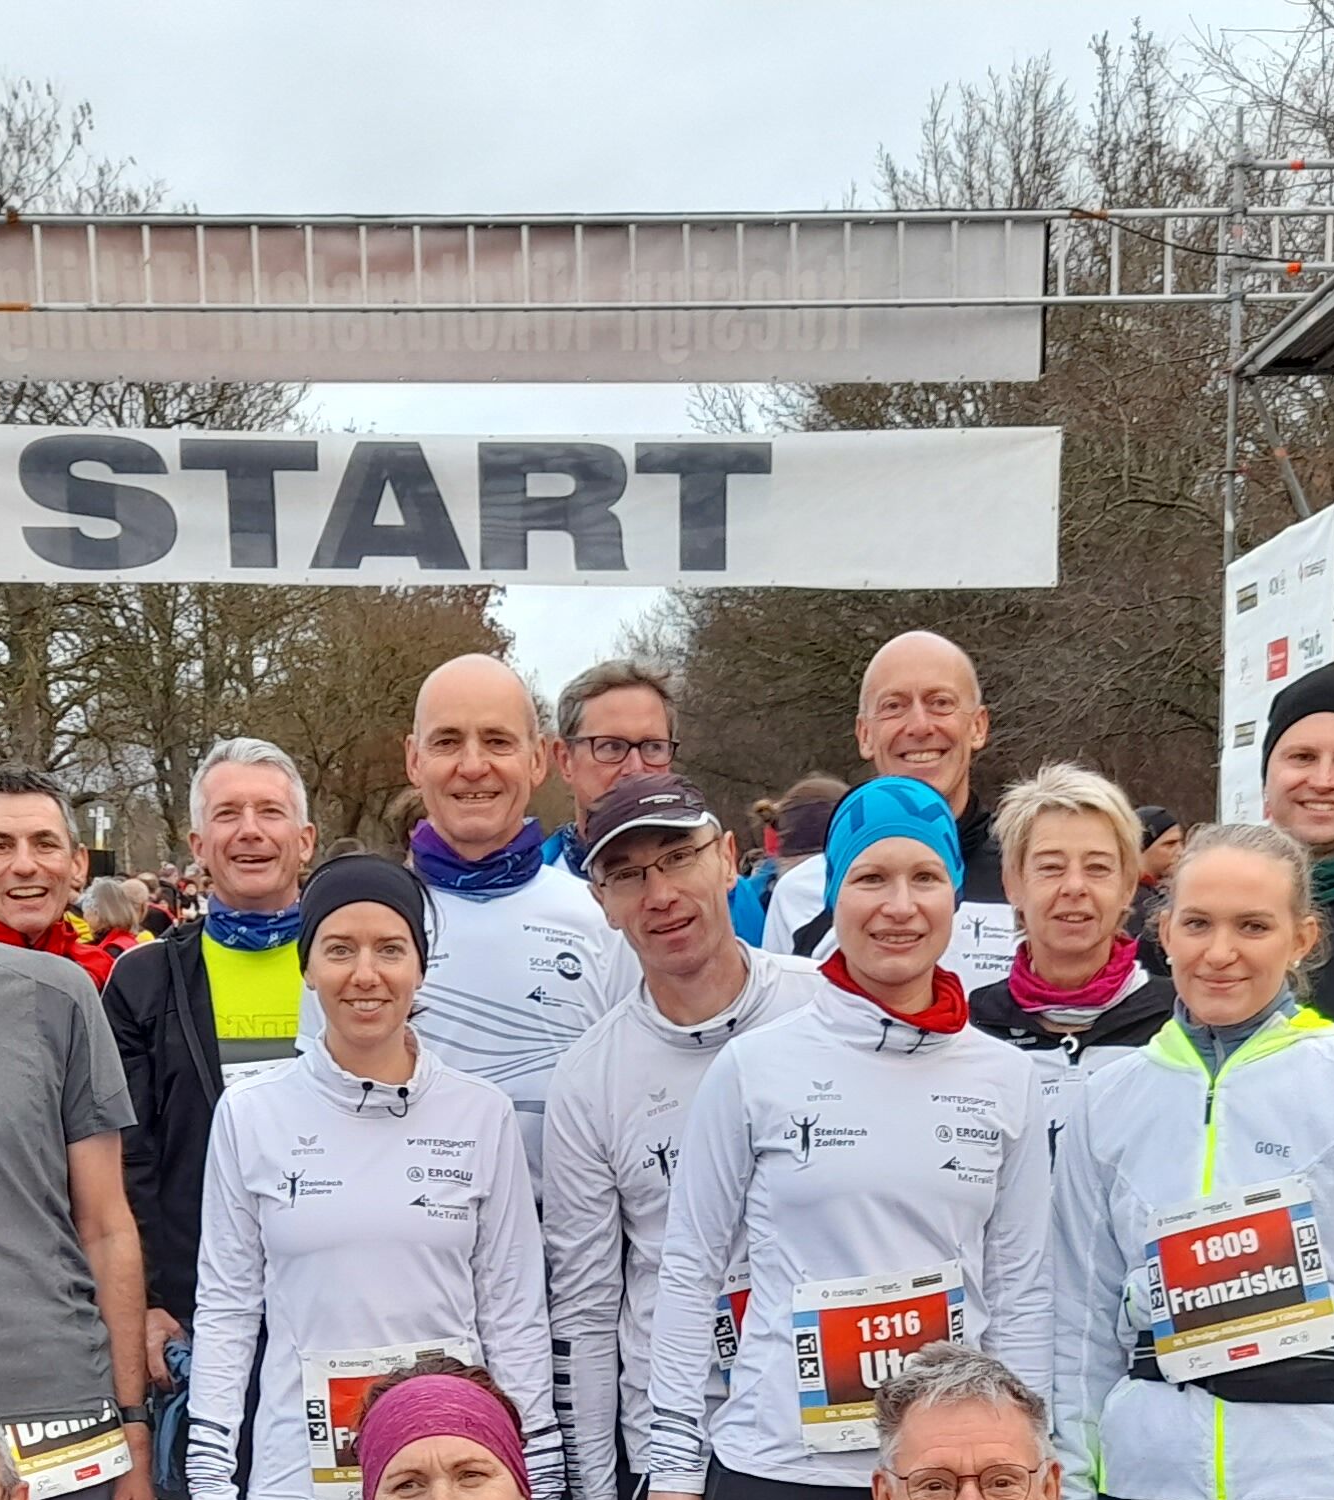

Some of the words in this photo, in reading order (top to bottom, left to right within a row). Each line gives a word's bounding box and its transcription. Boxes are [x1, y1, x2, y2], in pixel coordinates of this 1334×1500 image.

[18, 433, 772, 571] START
[783, 1128, 798, 1140] LG
[813, 1127, 868, 1138] Steinlach
[956, 1127, 1000, 1141] EROGLU
[416, 1138, 477, 1150] INTERSPORT
[814, 1137, 856, 1148] Zollern
[427, 1168, 473, 1182] EROGLU
[1189, 1227, 1259, 1266] 1809
[1168, 1265, 1300, 1315] Franziska
[856, 1310, 921, 1342] 1316
[1278, 1335, 1300, 1346] AOK
